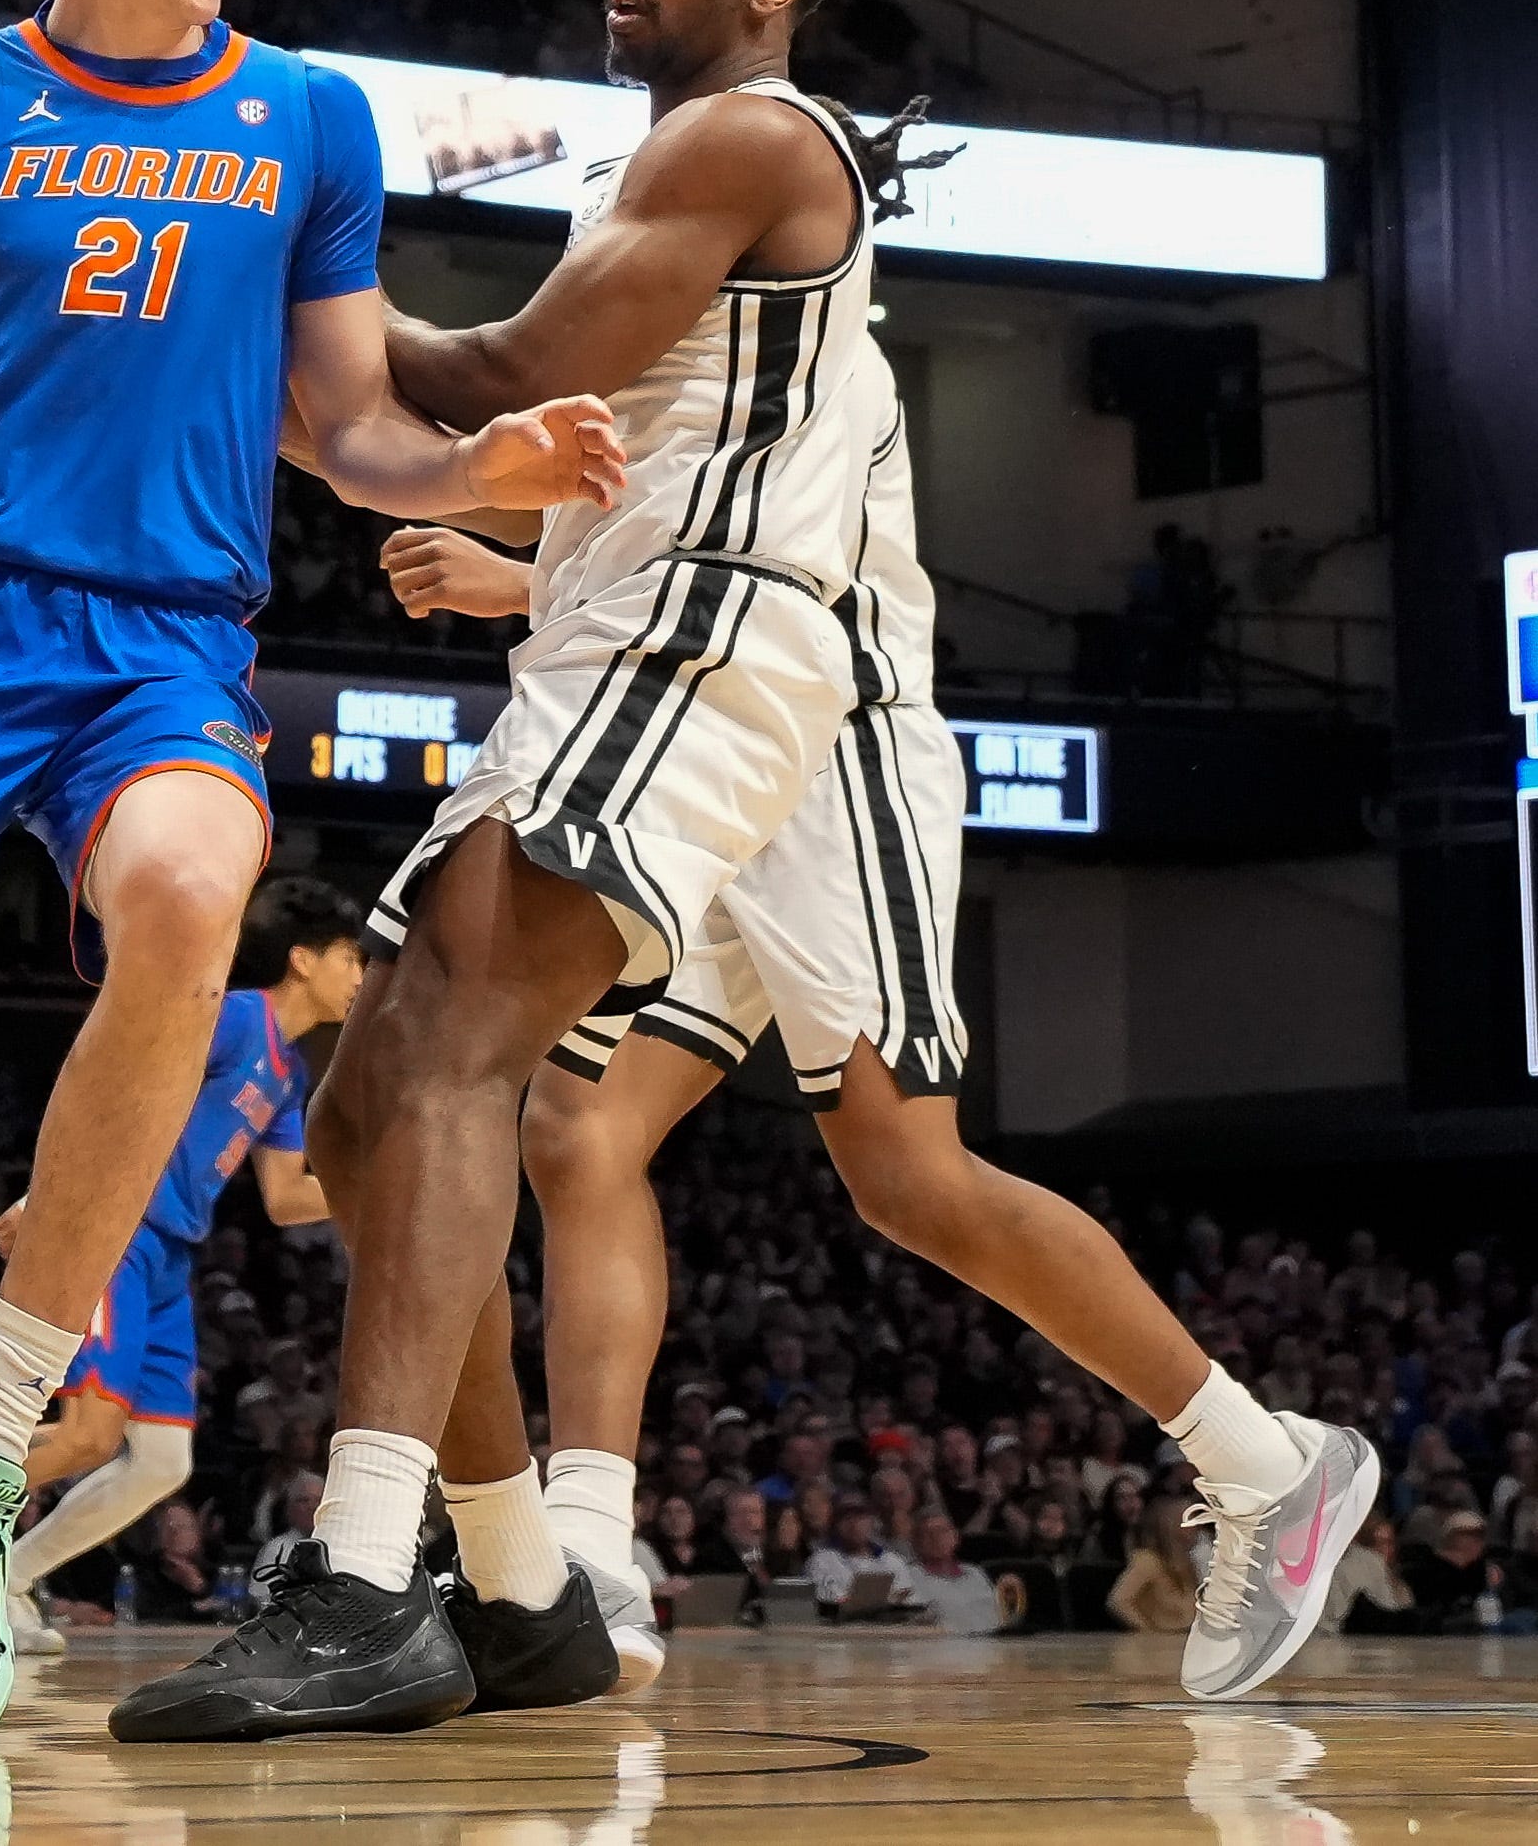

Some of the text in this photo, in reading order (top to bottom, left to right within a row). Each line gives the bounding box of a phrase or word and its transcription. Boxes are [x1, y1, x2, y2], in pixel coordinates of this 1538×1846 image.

[240, 99, 267, 123] SEC
[59, 216, 190, 320] 21
[563, 823, 597, 870] V
[913, 1036, 940, 1083] V
